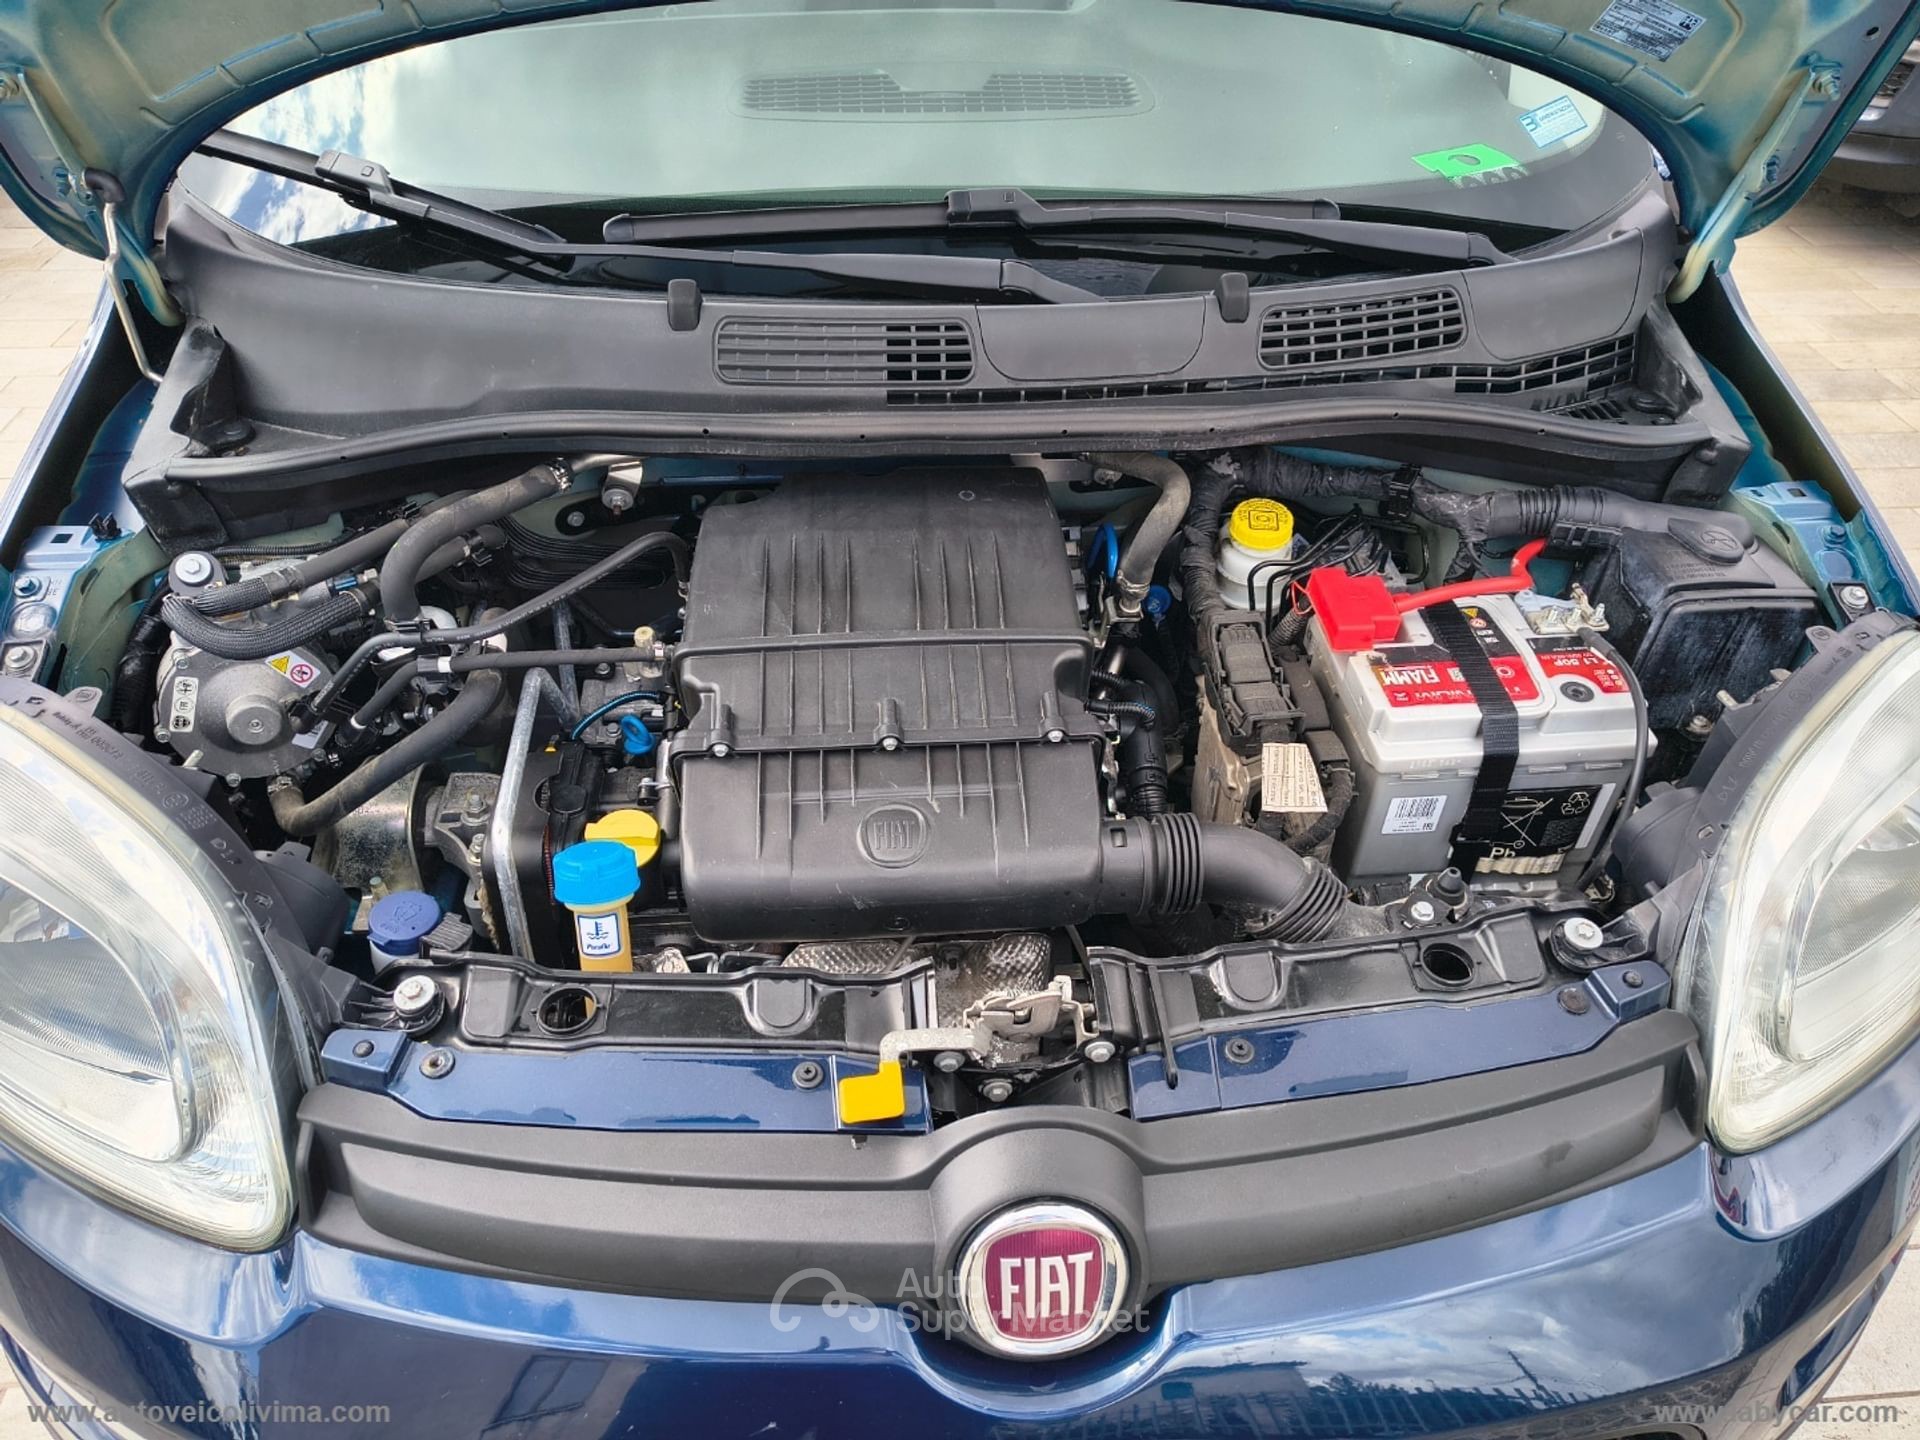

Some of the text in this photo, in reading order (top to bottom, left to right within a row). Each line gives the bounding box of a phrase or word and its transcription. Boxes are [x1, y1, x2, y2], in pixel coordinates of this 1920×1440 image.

[1380, 667, 1440, 686] FIAMM
[874, 816, 917, 851] FIAT
[999, 1251, 1094, 1320] FIAT
